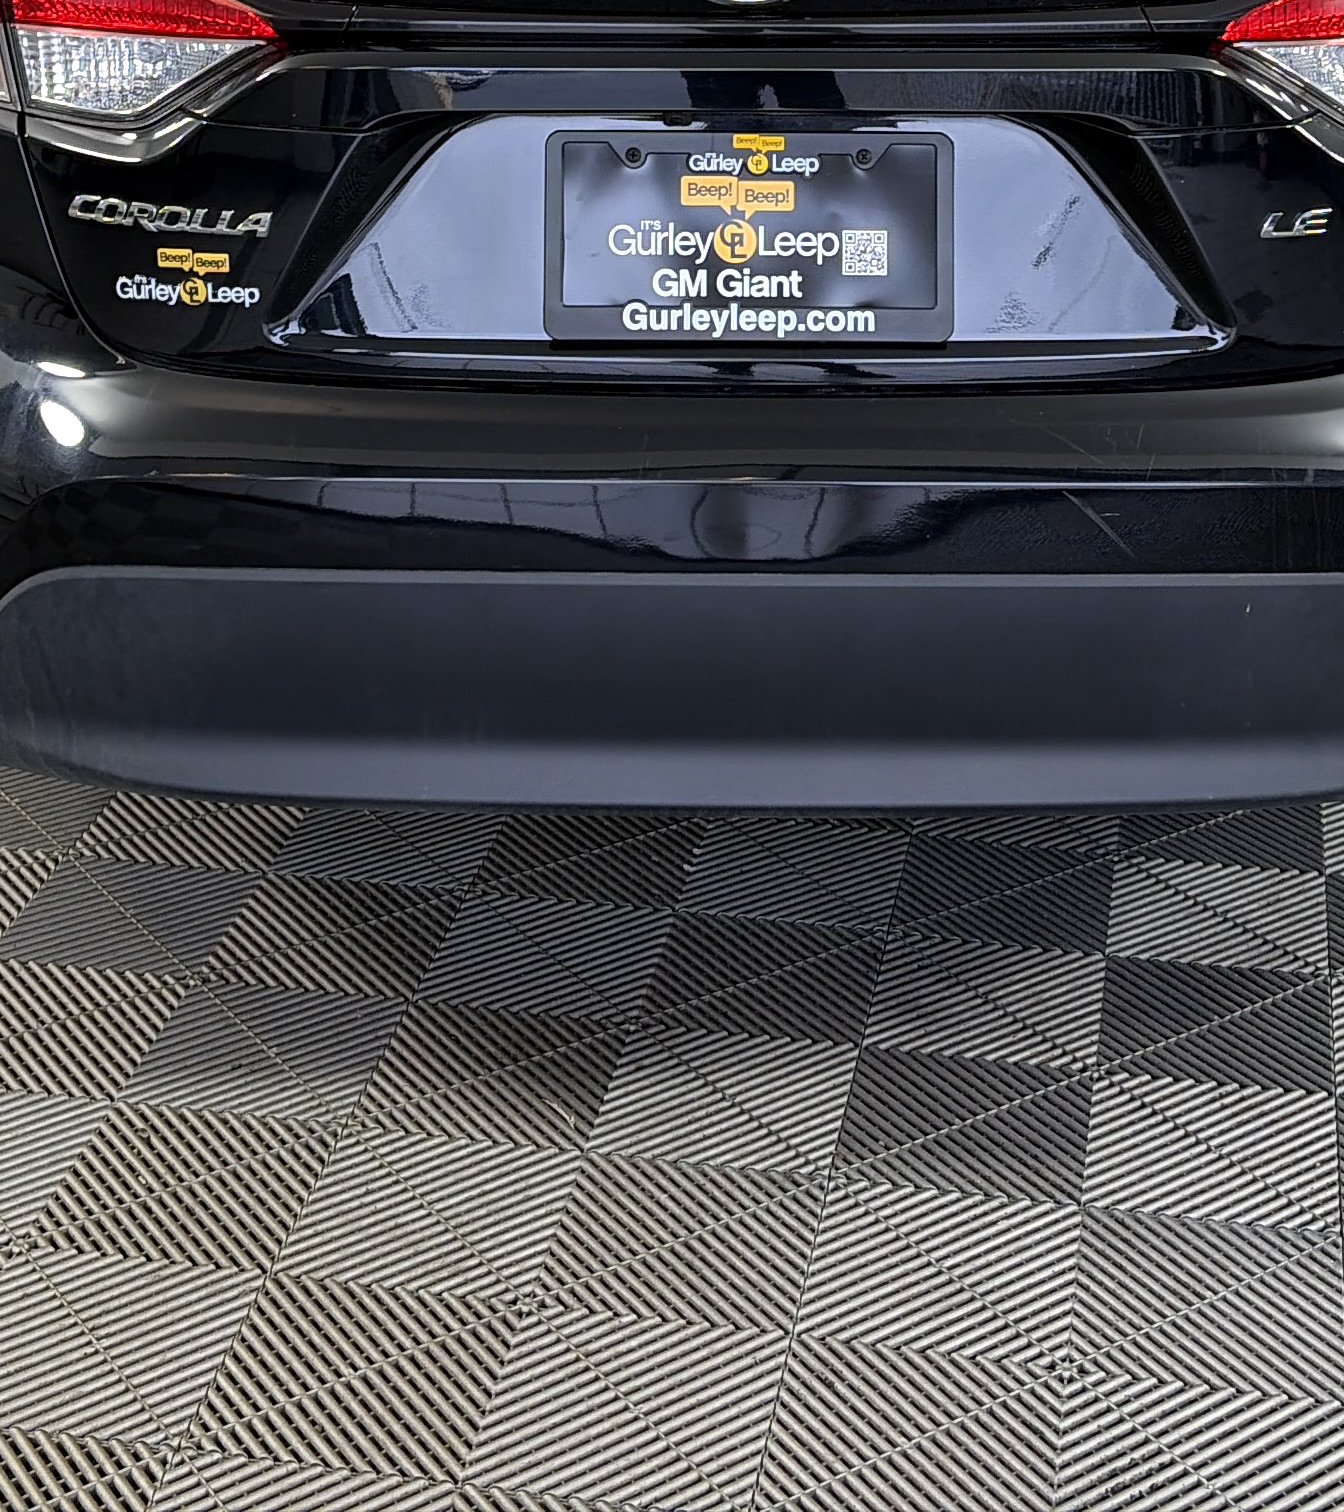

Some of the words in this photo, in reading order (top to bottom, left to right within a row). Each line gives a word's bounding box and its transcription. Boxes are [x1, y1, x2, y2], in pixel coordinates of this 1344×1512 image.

[688, 152, 744, 176] Gurley
[772, 153, 820, 177] Leep
[687, 182, 733, 200] Beep!
[744, 188, 790, 206] Beep!
[68, 194, 274, 238] COROLLA
[640, 219, 662, 231] IT'S
[1260, 207, 1333, 238] LE
[608, 222, 715, 265] Gurley
[758, 225, 840, 265] Leep
[159, 251, 192, 266] Beep!
[195, 257, 228, 270] Beep!
[116, 277, 182, 306] Gurley
[206, 282, 261, 308] Leep
[652, 268, 708, 298] GM
[716, 267, 803, 298] Giant
[622, 303, 876, 338] Gurleyleep.com
